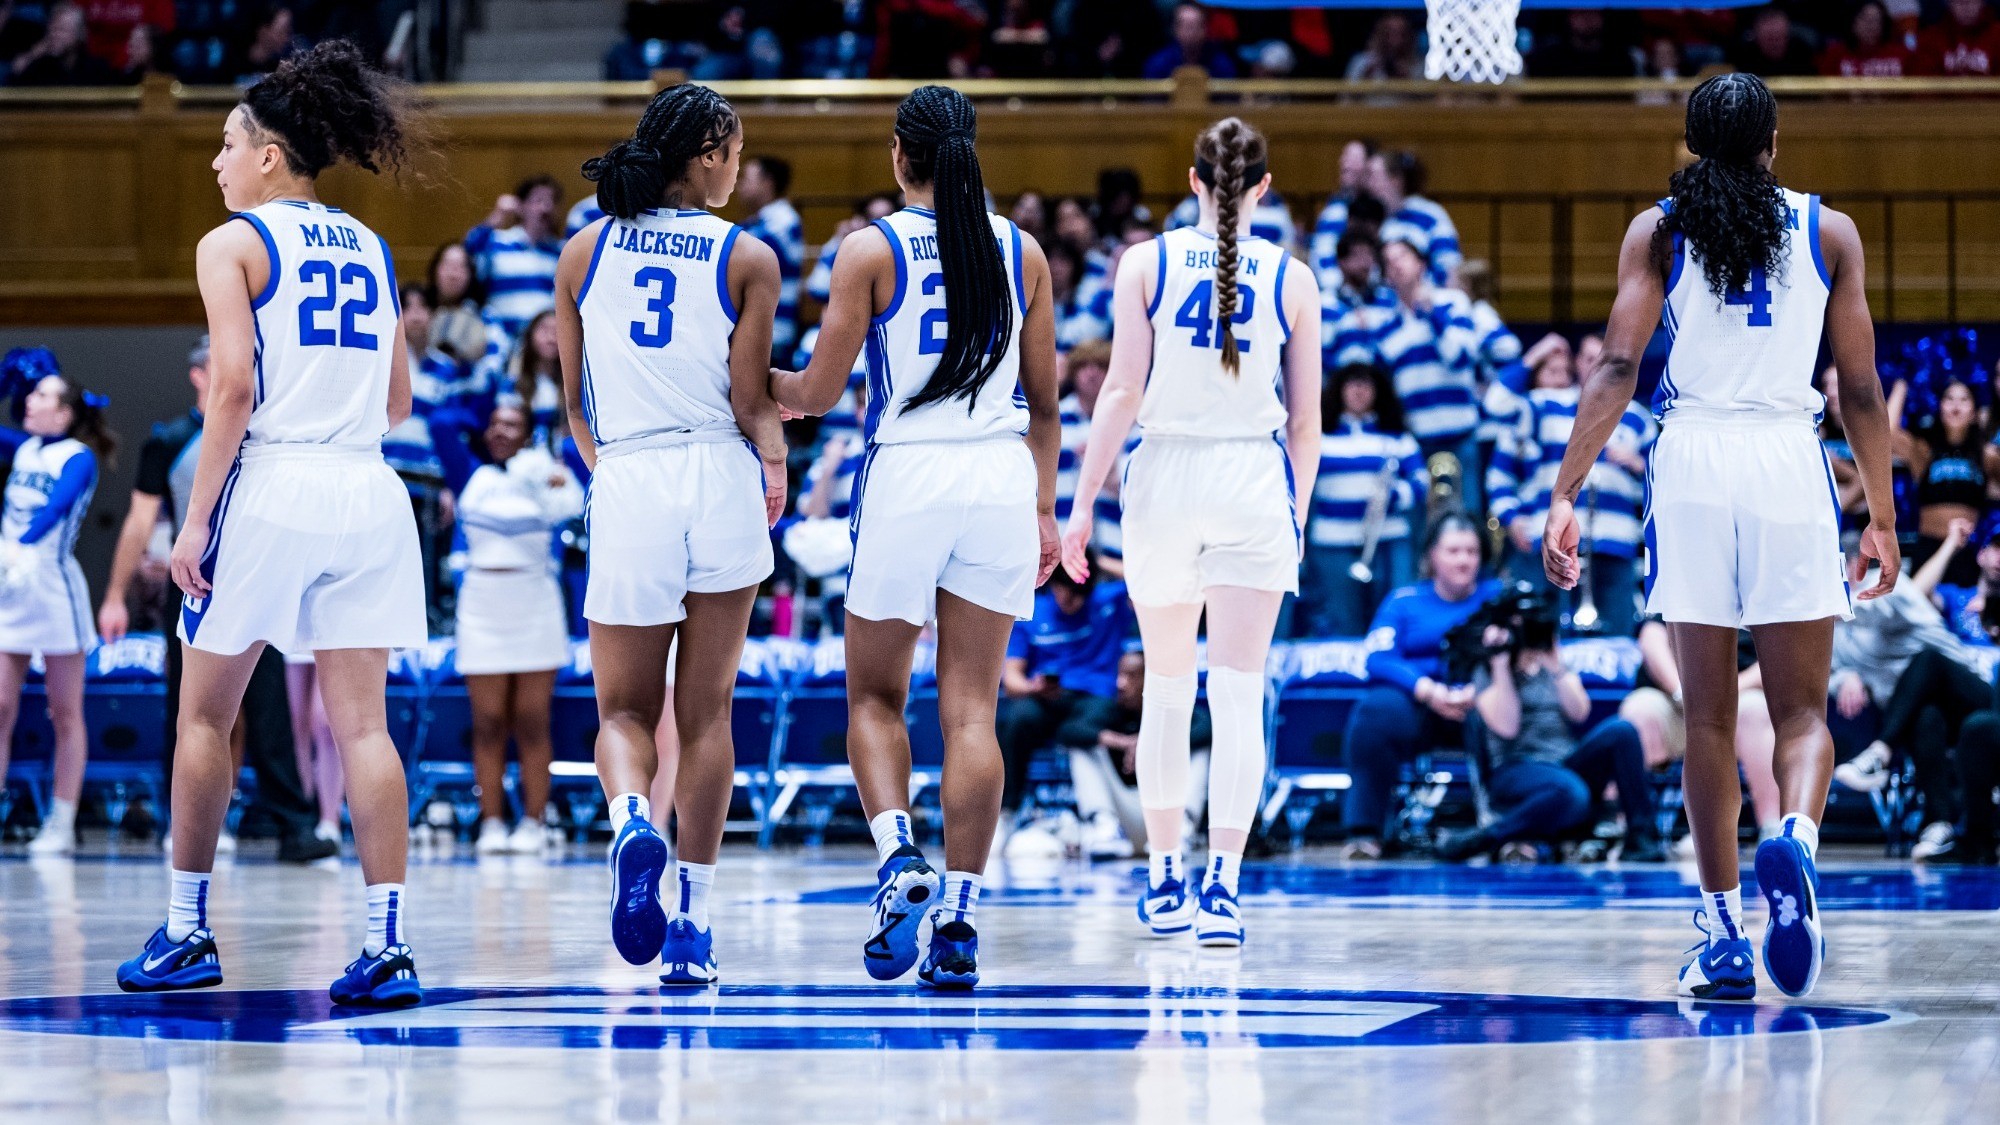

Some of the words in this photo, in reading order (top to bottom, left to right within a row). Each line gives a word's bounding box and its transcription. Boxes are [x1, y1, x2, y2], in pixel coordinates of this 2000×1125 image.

[299, 224, 362, 252] MAIR
[613, 226, 715, 262] JACKSON
[1185, 250, 1259, 275] BRON
[298, 260, 378, 351] 22
[630, 266, 677, 349] 3
[1174, 279, 1256, 353] 42
[675, 963, 685, 971] 07
